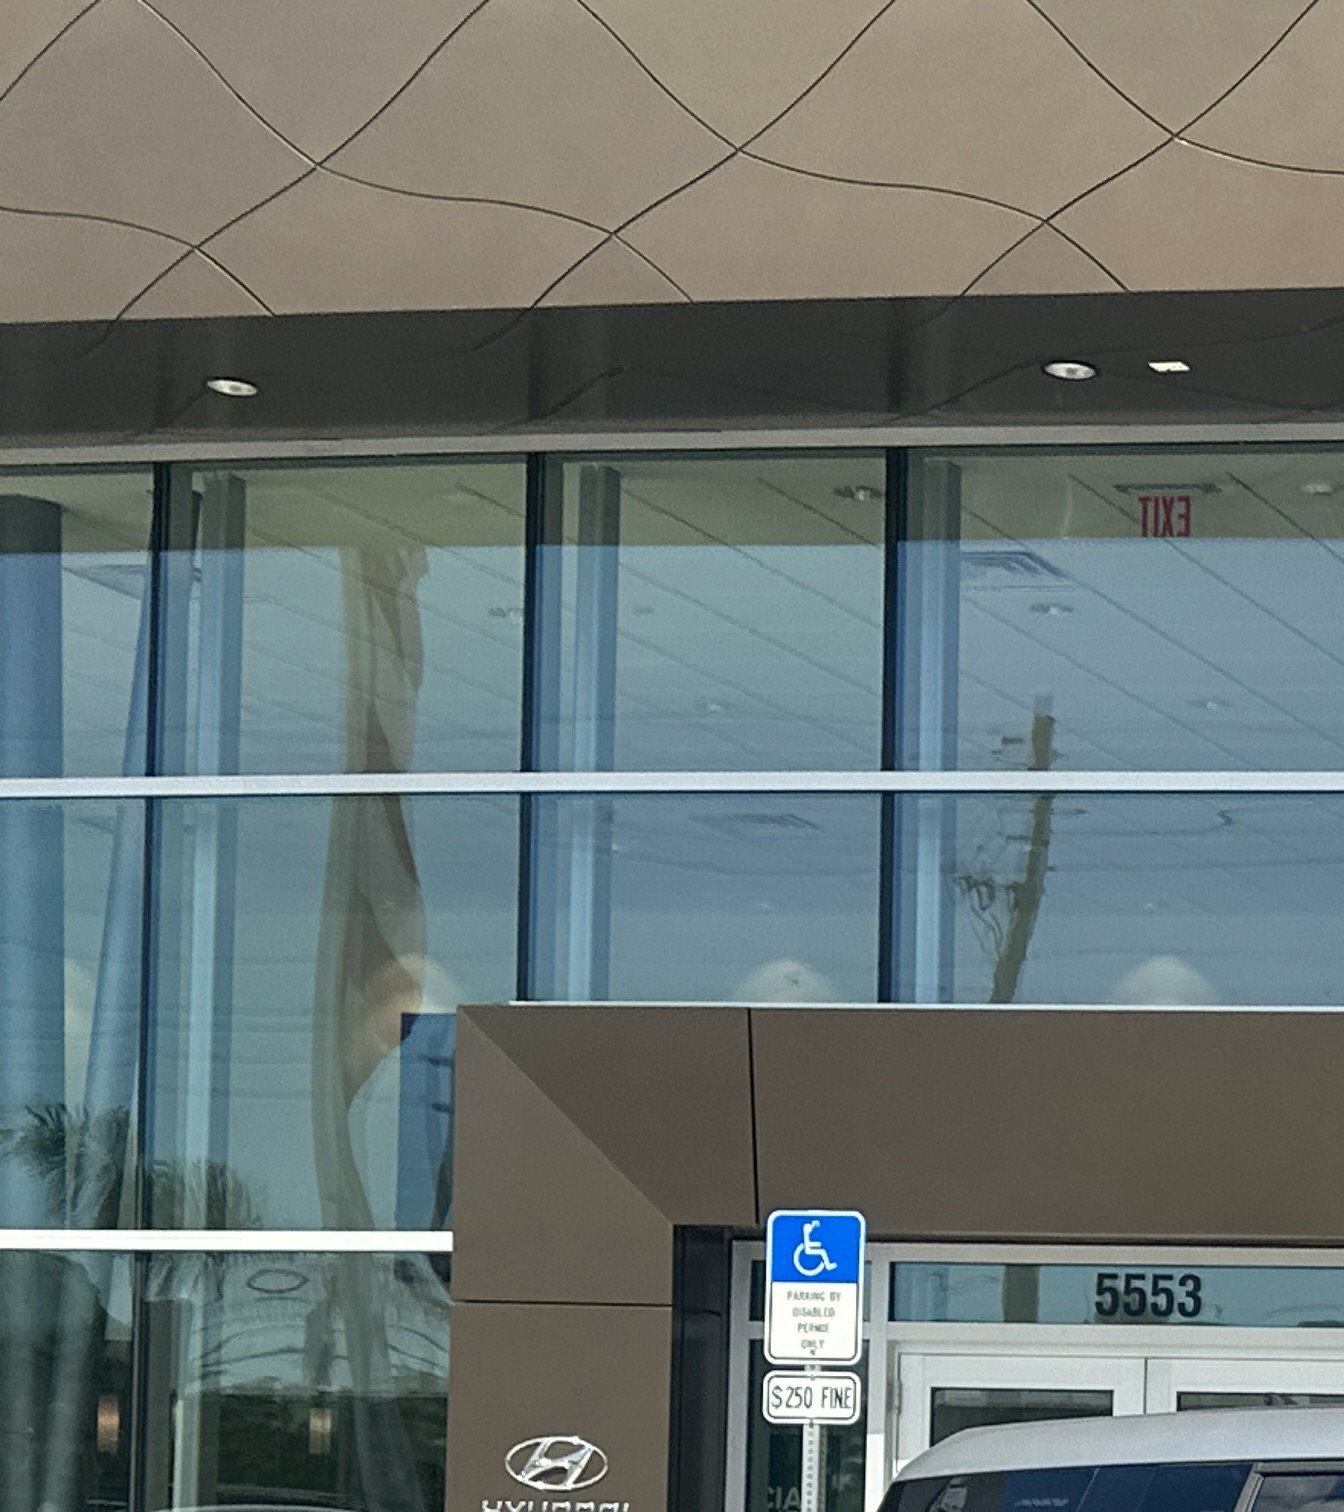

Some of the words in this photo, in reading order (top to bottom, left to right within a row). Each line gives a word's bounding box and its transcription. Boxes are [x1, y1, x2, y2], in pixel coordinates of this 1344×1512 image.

[1094, 1272, 1203, 1318] 5553
[771, 1385, 813, 1409] $250
[821, 1386, 852, 1409] FINE
